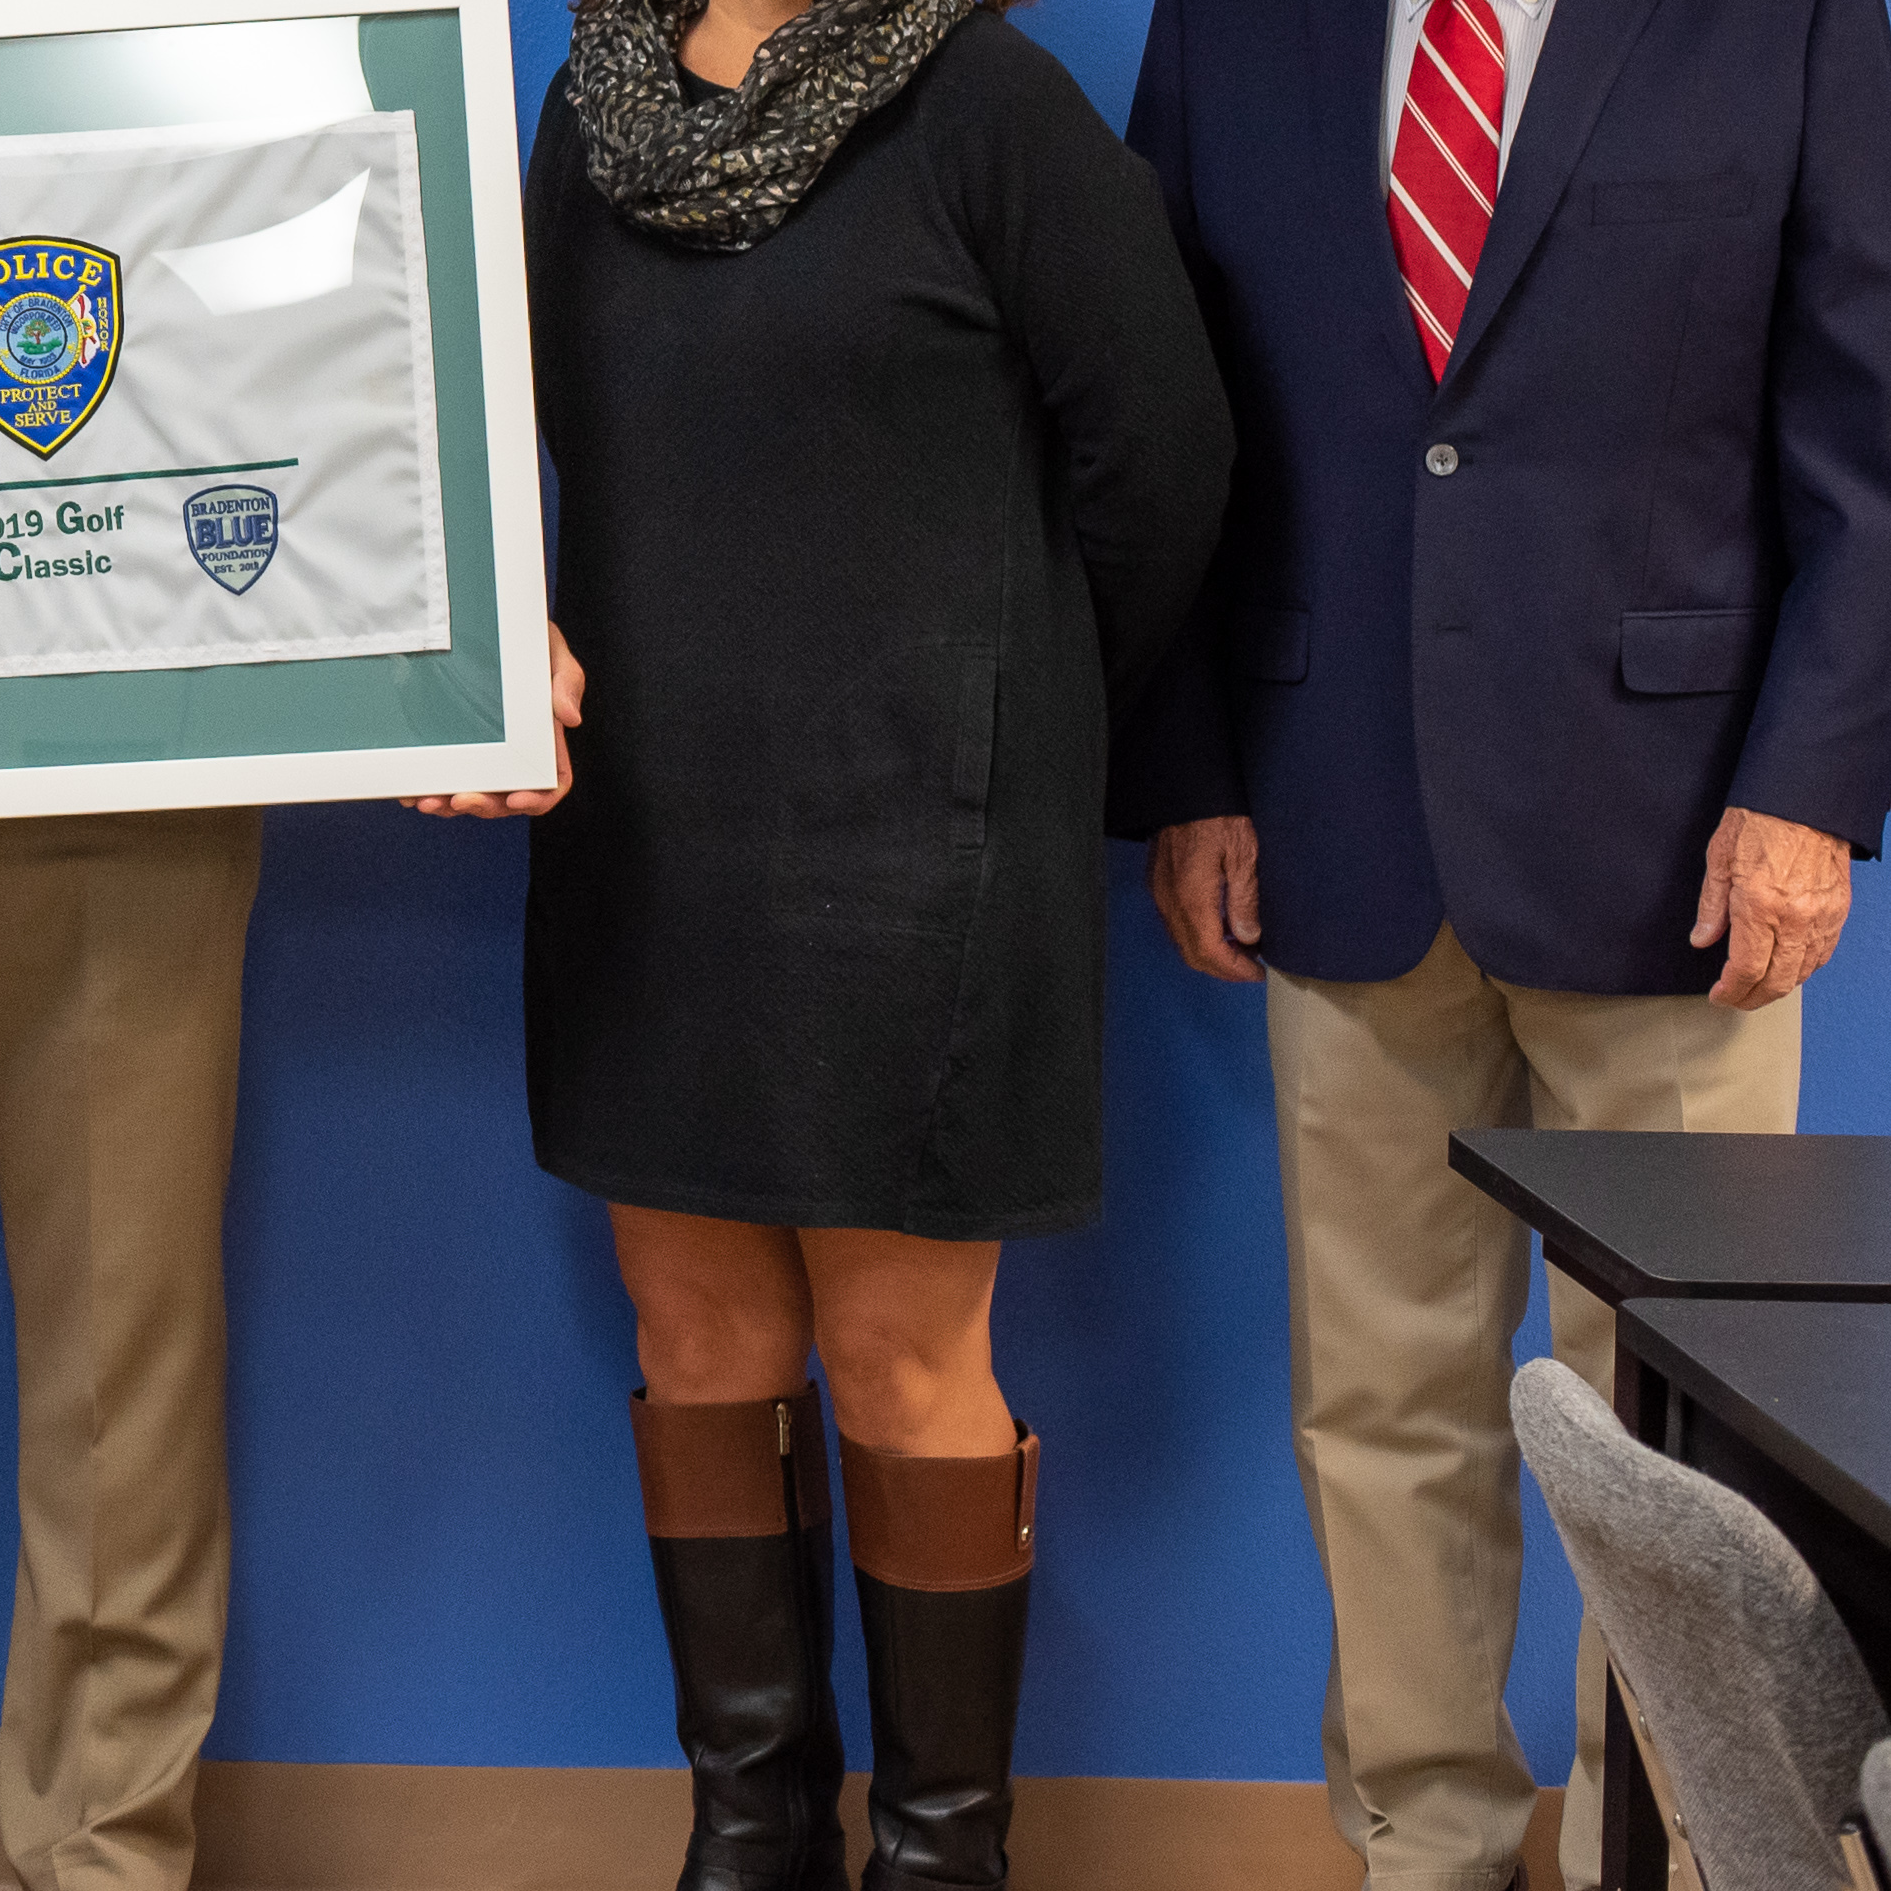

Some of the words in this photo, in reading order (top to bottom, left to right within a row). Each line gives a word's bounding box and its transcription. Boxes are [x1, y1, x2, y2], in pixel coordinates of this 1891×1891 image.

[20, 365, 61, 379] FLORIDA
[0, 384, 83, 404] PROTECT
[27, 401, 57, 413] AND
[14, 411, 72, 427] SERVE
[191, 497, 270, 517] BRADENTON
[56, 501, 124, 534] Golf
[195, 514, 273, 550] BLUE
[201, 549, 269, 562] FOUNDATION
